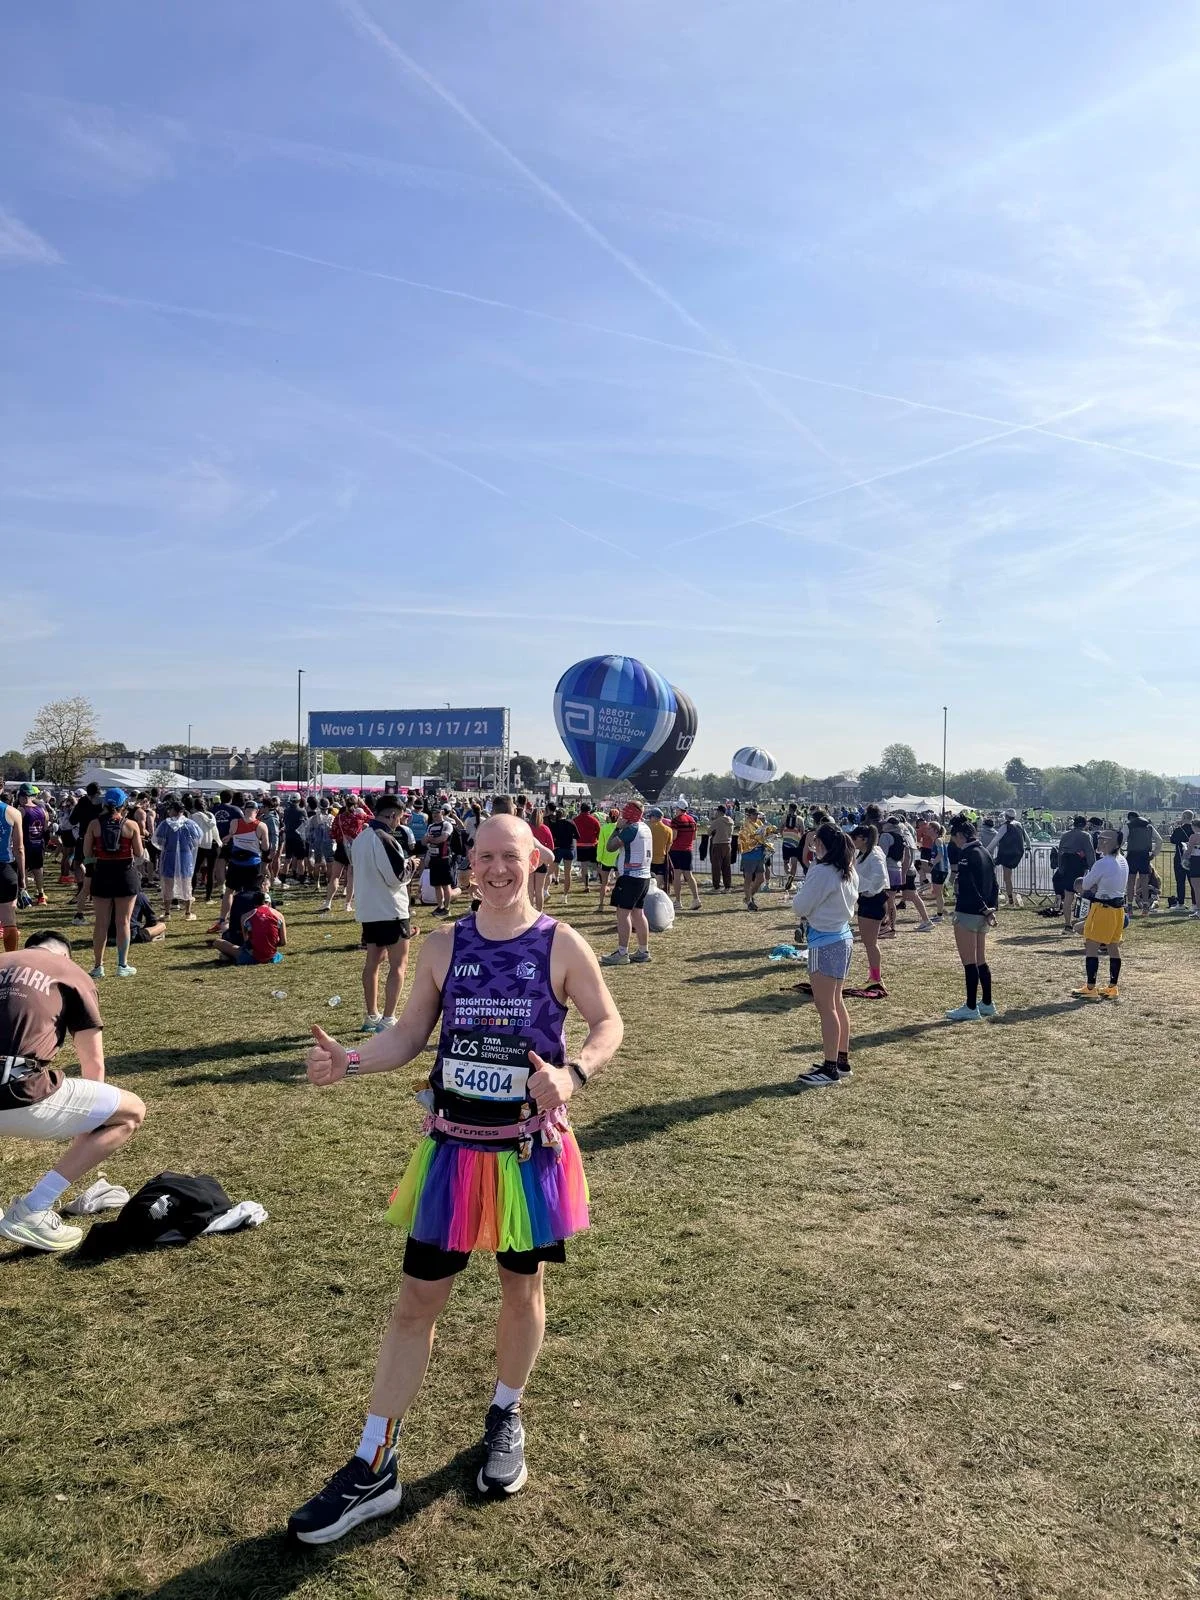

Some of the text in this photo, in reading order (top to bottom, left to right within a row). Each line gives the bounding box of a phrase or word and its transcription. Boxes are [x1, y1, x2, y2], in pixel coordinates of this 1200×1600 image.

[599, 707, 636, 720] ABBOTT
[599, 715, 630, 727] WORLD
[320, 723, 355, 736] Wave
[376, 722, 385, 735] 5
[397, 722, 405, 735] 9
[418, 722, 433, 735] 13
[446, 721, 460, 735] 17
[474, 721, 488, 735] 21
[598, 724, 646, 737] MARATHON
[597, 731, 632, 742] MAJORS
[454, 964, 480, 977] VIN
[455, 998, 500, 1006] BRIGHTON
[507, 998, 532, 1007] HOVE
[455, 1007, 531, 1017] FRONTRUNNERS
[483, 1037, 501, 1045] TATA
[481, 1045, 526, 1055] CONSULTANCY
[481, 1052, 509, 1061] SERVICES
[454, 1067, 513, 1094] 54804
